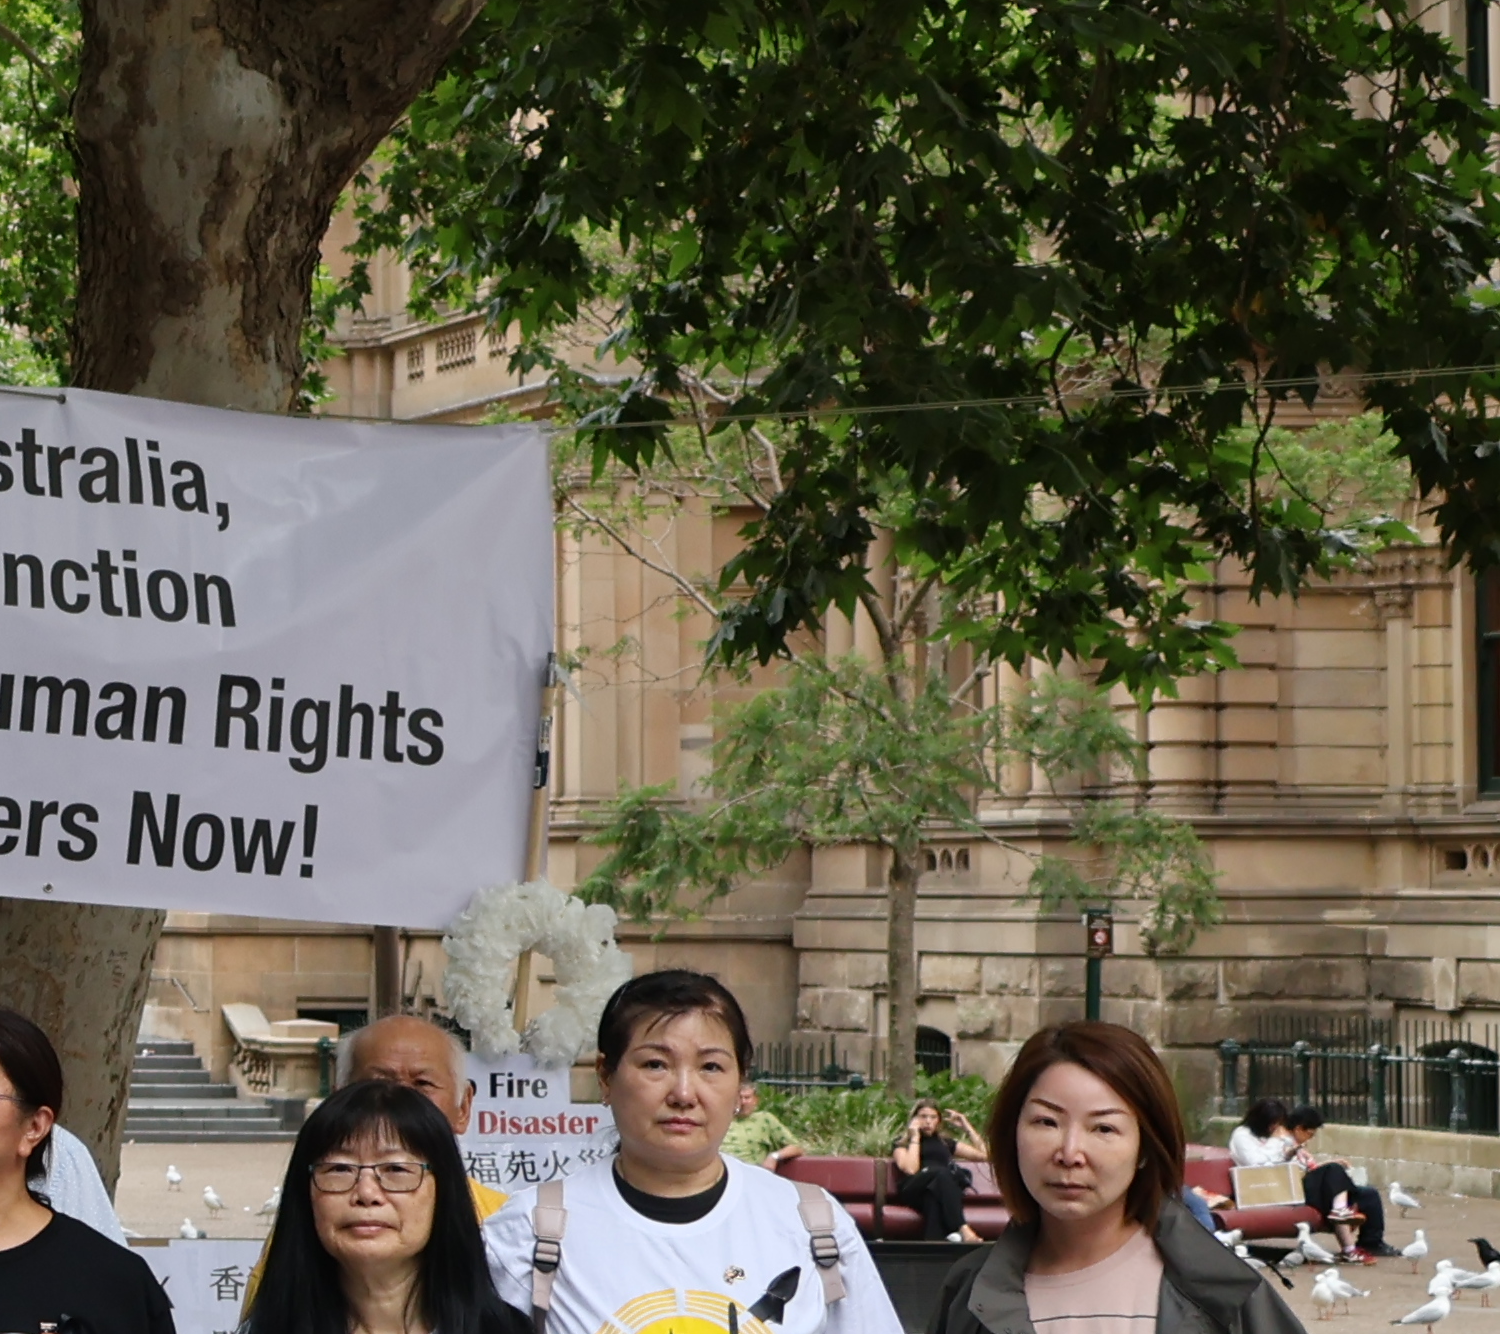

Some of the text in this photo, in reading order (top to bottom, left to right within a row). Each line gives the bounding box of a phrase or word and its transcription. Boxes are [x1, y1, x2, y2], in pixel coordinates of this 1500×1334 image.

[213, 673, 445, 774] Rights
[126, 790, 319, 880] Now!
[489, 1071, 549, 1099] Fire
[477, 1110, 599, 1135] Disaster
